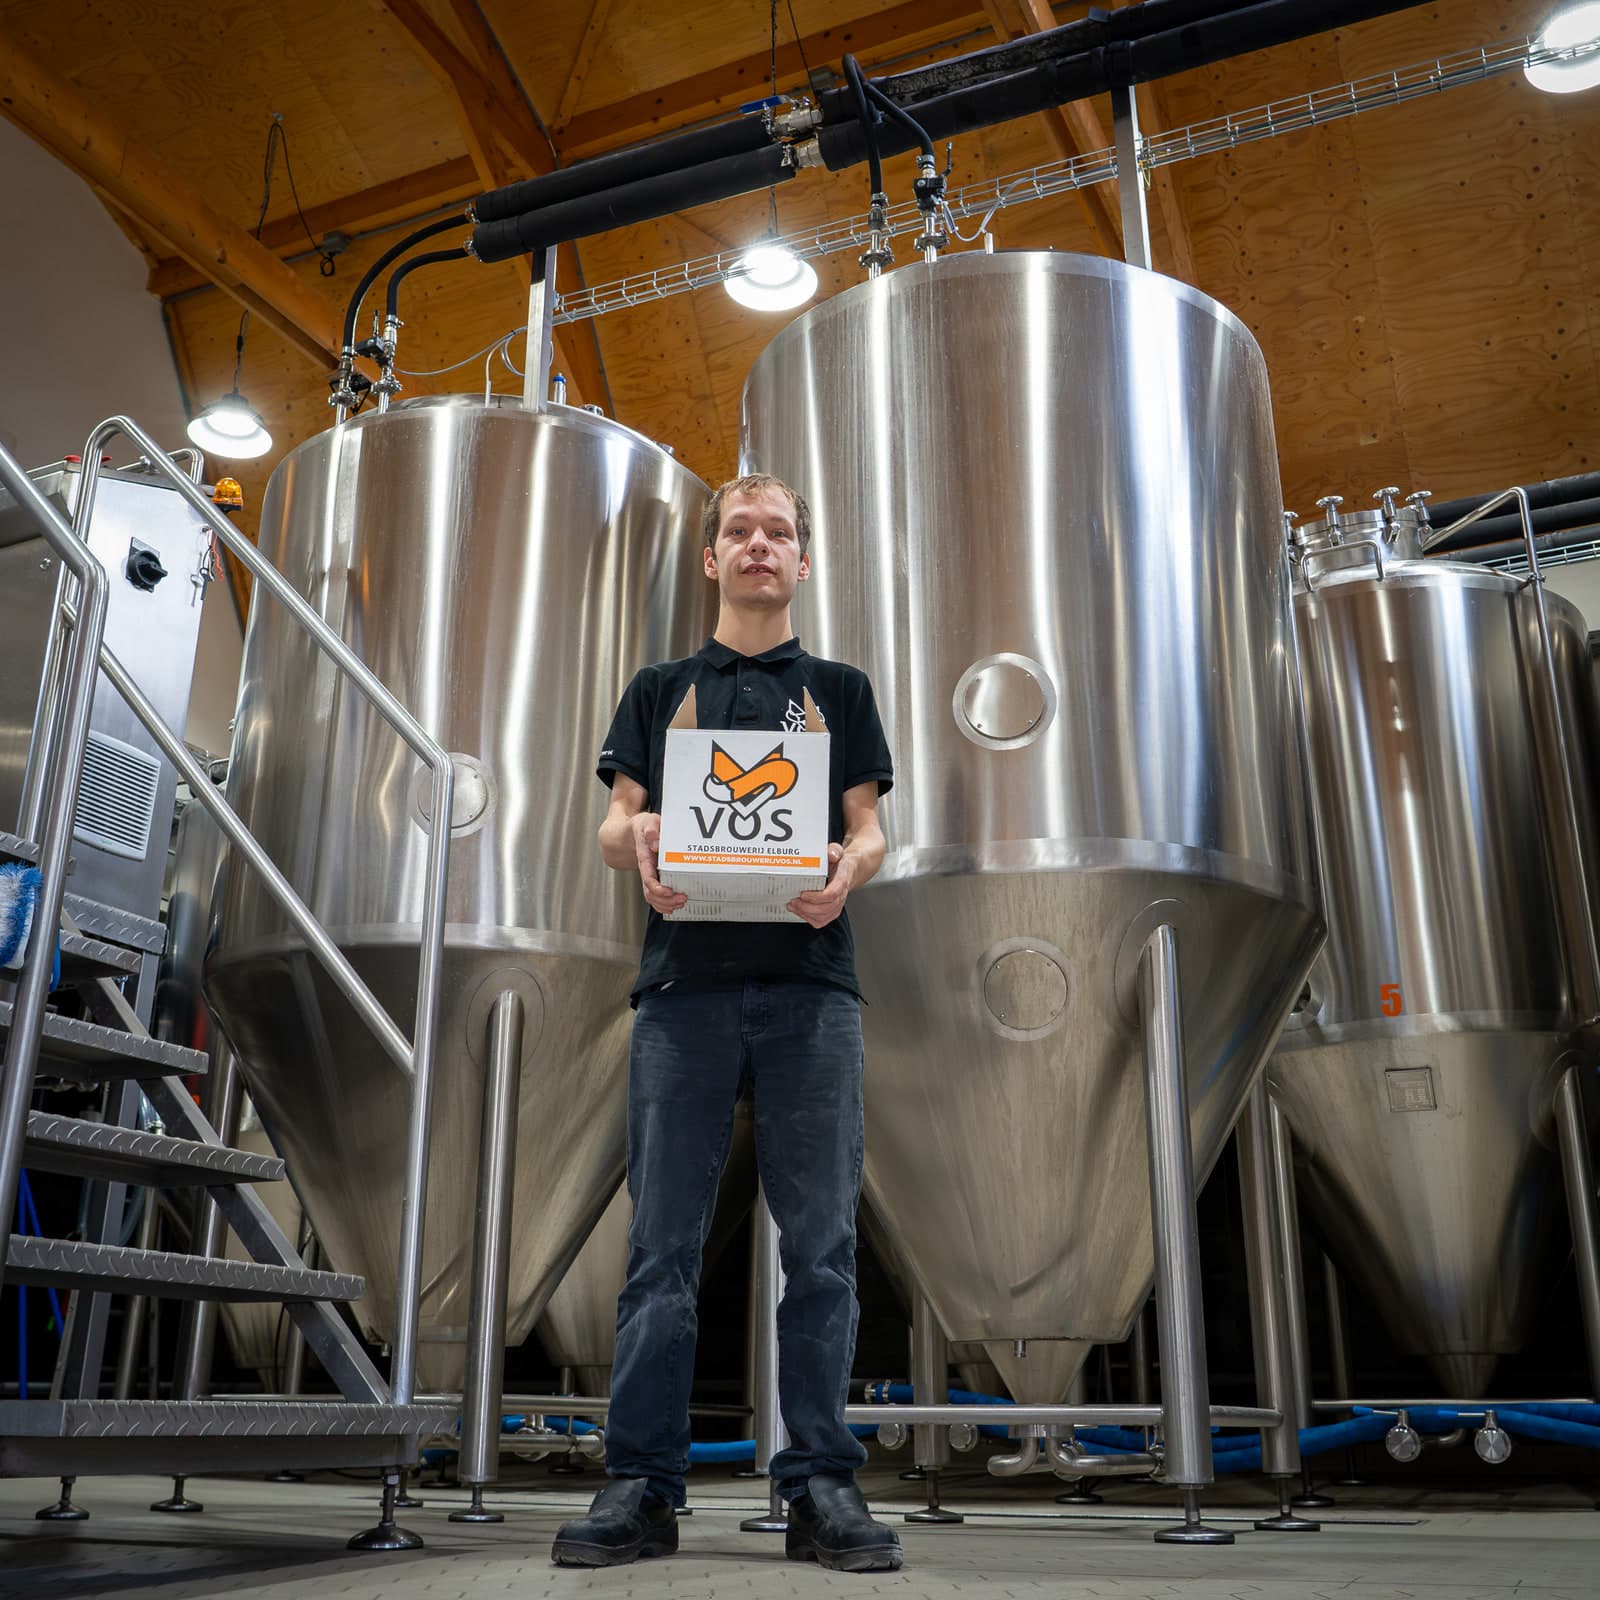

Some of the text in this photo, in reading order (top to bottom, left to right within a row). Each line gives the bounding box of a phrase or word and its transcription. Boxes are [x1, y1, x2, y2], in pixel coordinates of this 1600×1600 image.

[689, 806, 793, 842] VOS
[683, 855, 803, 865] WWW.STADSBROUWERIJVOS.NL
[687, 844, 800, 856] STADSBROUWERIJ ELBURG
[1380, 984, 1402, 1017] 5
